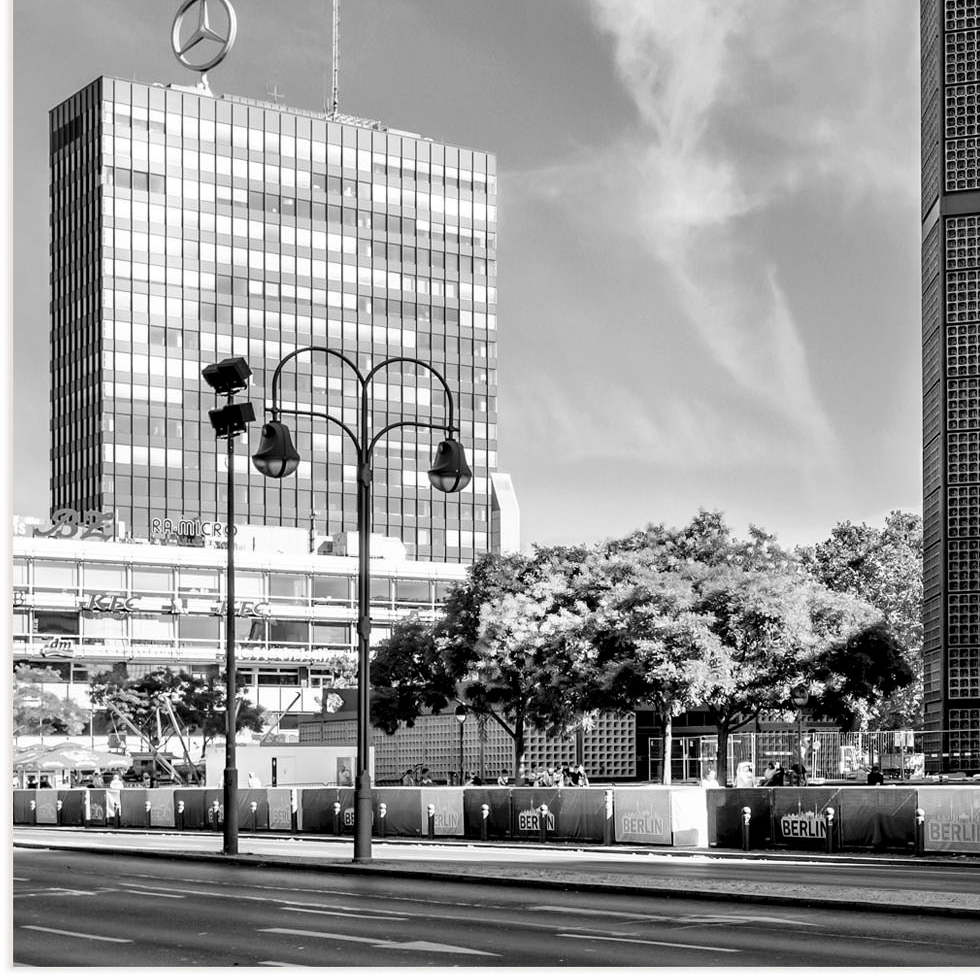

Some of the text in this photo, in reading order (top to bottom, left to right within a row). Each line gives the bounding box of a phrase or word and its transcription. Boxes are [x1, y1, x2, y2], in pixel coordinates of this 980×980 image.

[50, 638, 72, 649] dm
[434, 813, 457, 827] ERLIN
[520, 815, 553, 830] BERN
[623, 818, 661, 834] BERLIN
